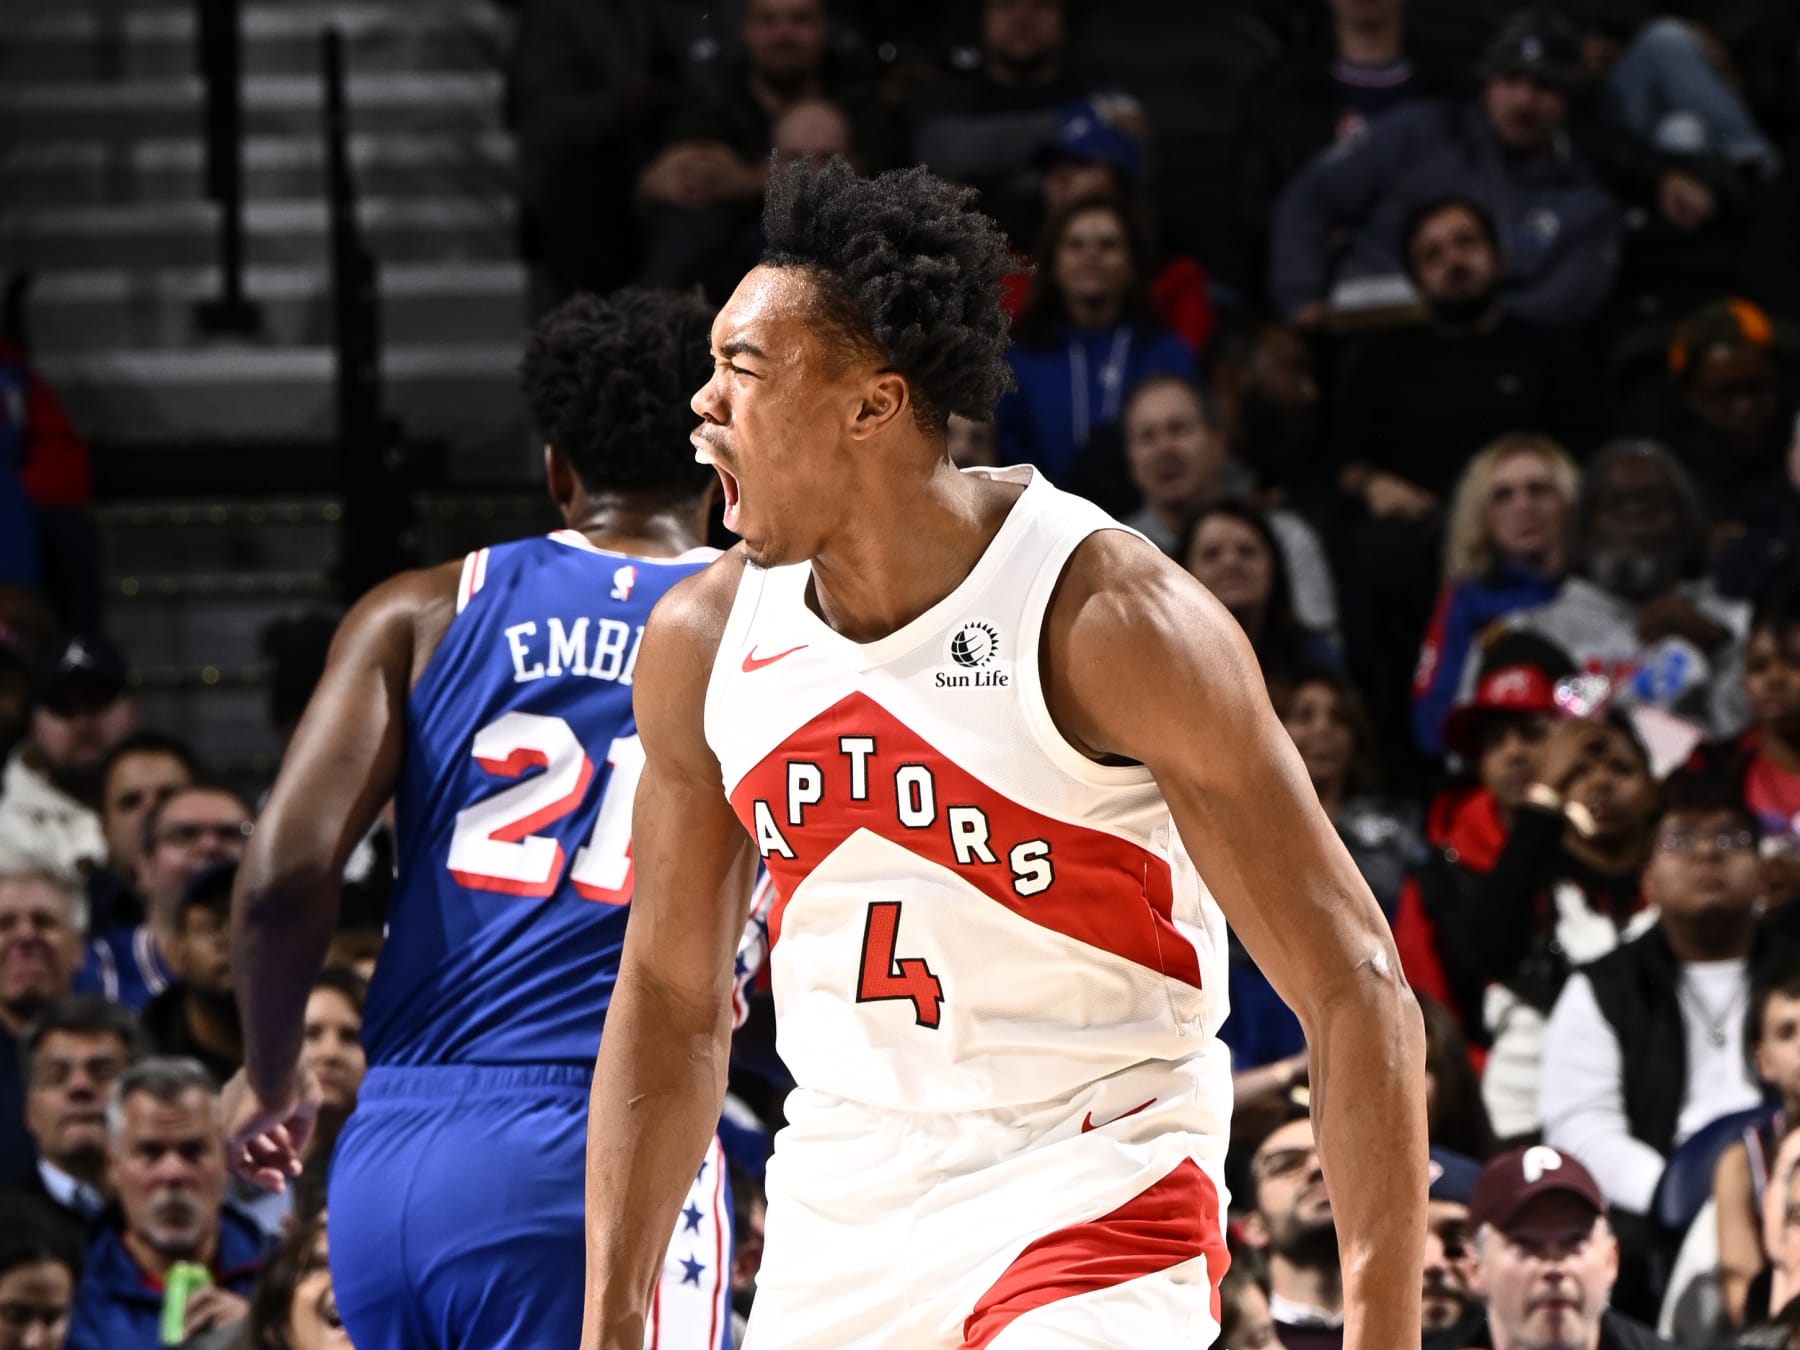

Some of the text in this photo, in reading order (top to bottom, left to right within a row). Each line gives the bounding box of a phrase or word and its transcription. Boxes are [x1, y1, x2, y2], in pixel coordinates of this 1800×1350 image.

[935, 669, 1009, 688] Sun Life
[446, 710, 647, 906] 21
[855, 900, 945, 1030] 4
[1522, 1145, 1562, 1184] P
